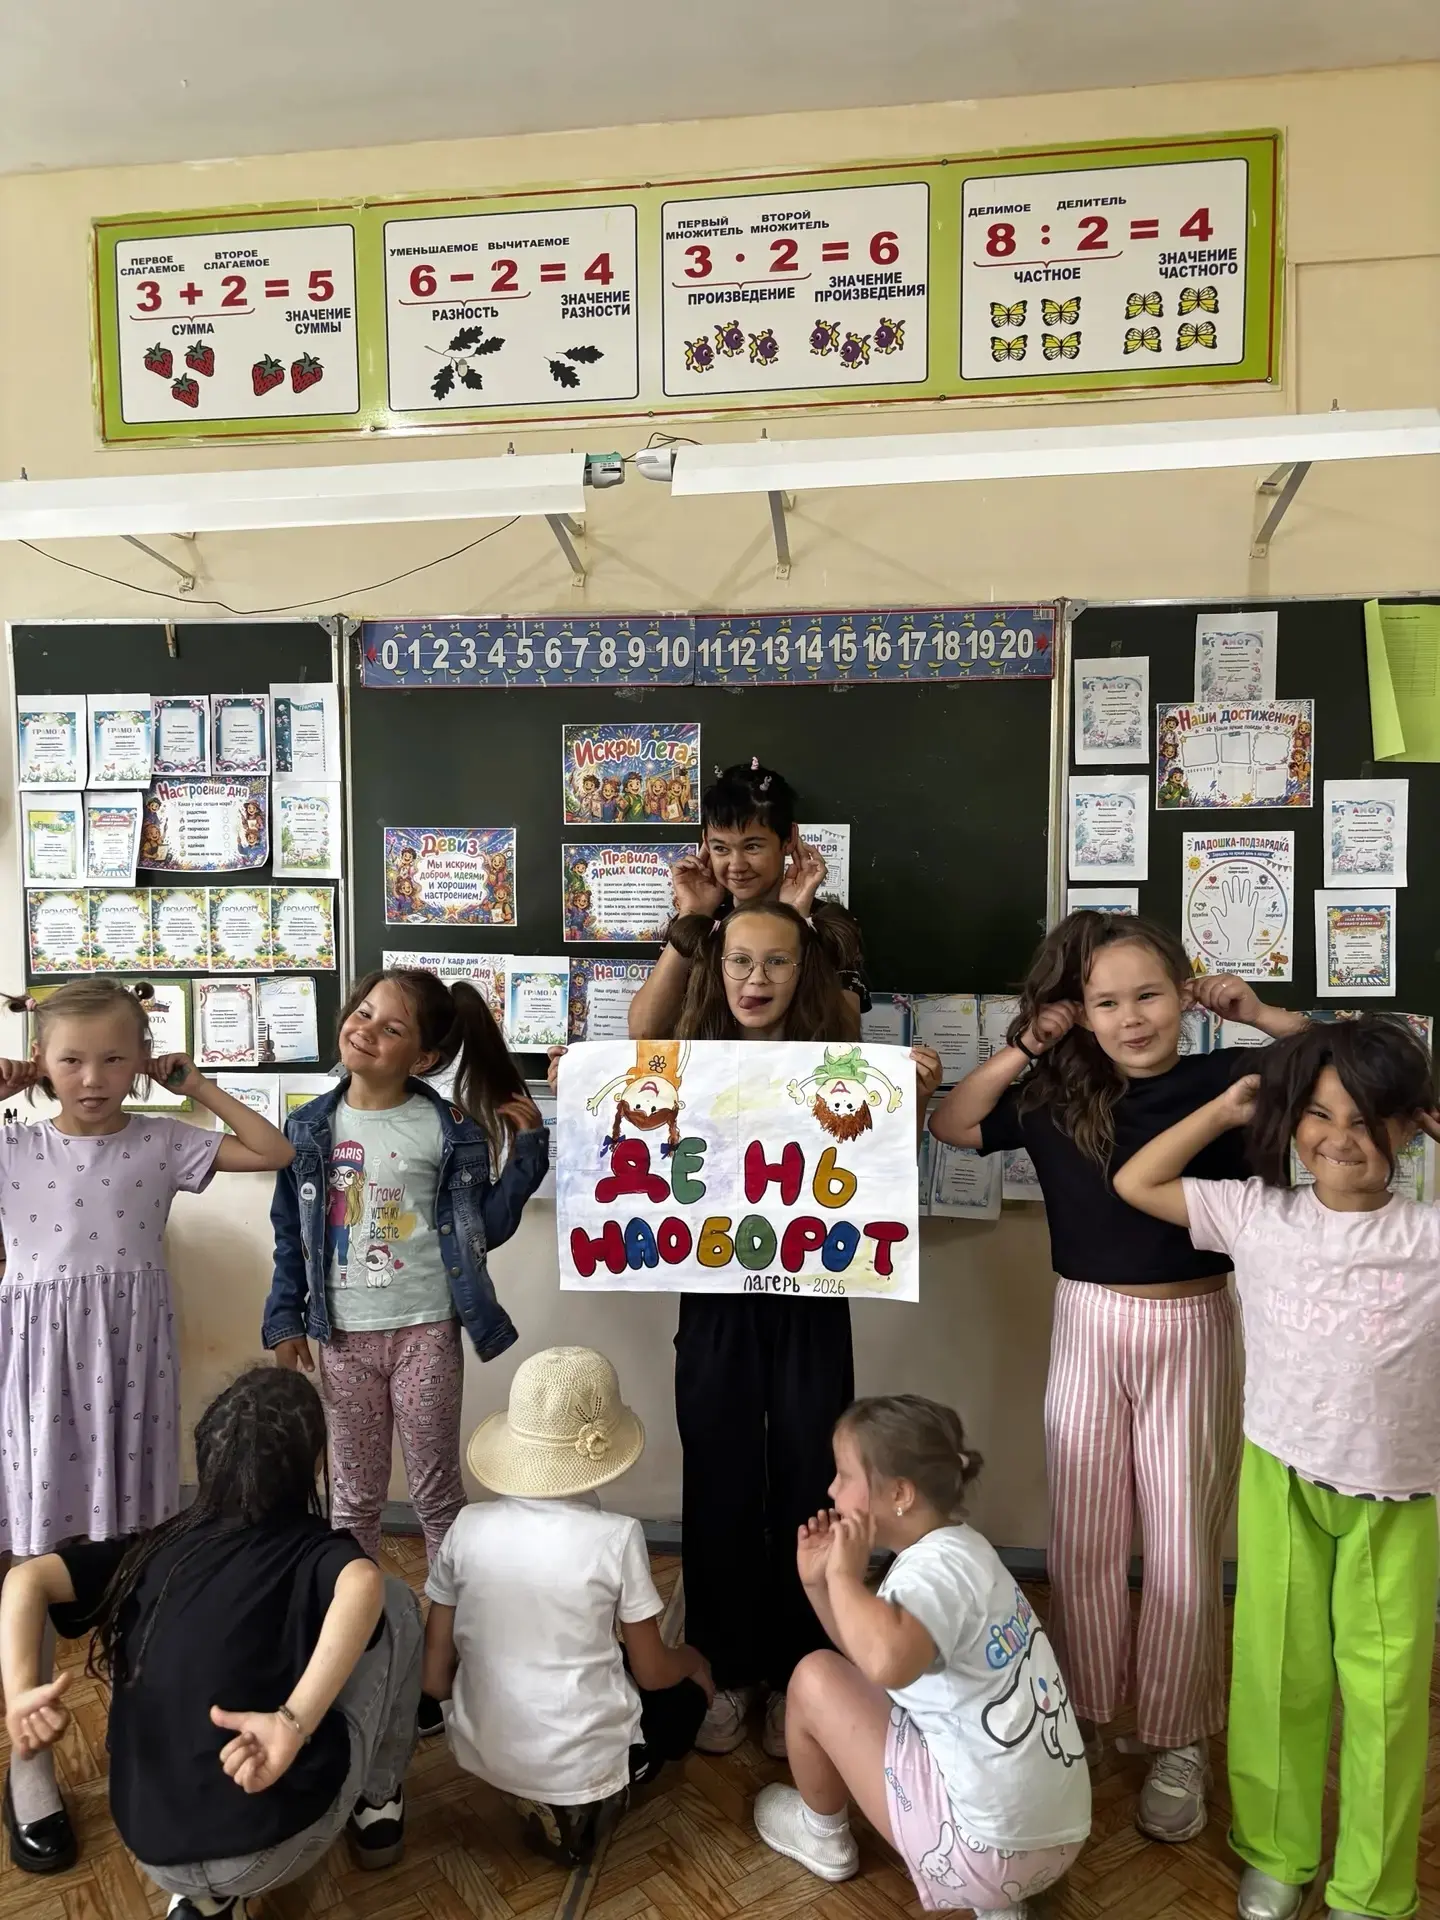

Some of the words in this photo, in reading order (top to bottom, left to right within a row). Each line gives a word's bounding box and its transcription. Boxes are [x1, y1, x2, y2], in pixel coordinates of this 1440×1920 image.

[968, 203, 1031, 217] ДЕЛИМОЕ
[1057, 196, 1127, 211] ДЕЛИТЕЛЬ
[678, 216, 729, 230] ПЕРВЫЙ
[761, 210, 811, 224] ВТОРОЙ
[665, 225, 743, 241] МНОЖИТЕЛЬ
[750, 218, 830, 234] МНОЖИТЕЛЬ
[985, 222, 1016, 257] 8
[1078, 216, 1108, 252] 2
[1179, 208, 1213, 243] 4
[215, 249, 258, 260] ВТОРОЕ
[389, 242, 478, 257] УМЕНЬШАЕМОЕ
[487, 237, 570, 251] ВЫЧИТАЕМОЕ
[684, 244, 712, 278] 3
[770, 240, 798, 273] 2
[870, 231, 900, 266] 6
[130, 255, 174, 266] ПЕРВОЕ
[204, 258, 270, 270] СЛАГАЕМОЕ
[1158, 248, 1237, 266] ЗНАЧЕНИЕ
[120, 264, 185, 275] СЛАГАЕМОЕ
[410, 264, 437, 298] 6
[490, 258, 518, 293] 2
[584, 252, 614, 286] 4
[1014, 267, 1081, 283] ЧАСТНОЕ
[1158, 262, 1238, 280] ЧАСТНОГО
[829, 272, 903, 288] ЗНАЧЕНИЕ
[136, 280, 162, 312] 3
[221, 275, 248, 308] 2
[307, 270, 334, 302] 5
[561, 290, 630, 308] ЗНАЧЕНИЕ
[688, 287, 796, 306] ПРОИЗВЕДЕНИЕ
[814, 283, 926, 303] ПРОИЗВЕДЕНИЯ
[284, 308, 352, 322] ЗНАЧЕНИЕ
[432, 306, 499, 322] РАЗНОСТЬ
[561, 304, 631, 320] РАЗНОСТИ
[172, 322, 215, 336] СУММА
[295, 320, 342, 336] СУММЫ
[811, 617, 822, 625] +1
[841, 616, 852, 624] +1
[902, 615, 913, 623] +1
[963, 613, 974, 621] +1
[994, 612, 1006, 620] +1
[382, 639, 398, 669] 0
[407, 639, 420, 669] 1
[433, 639, 449, 669] 2
[460, 638, 477, 669] 3
[487, 638, 506, 668] 4
[516, 639, 533, 668] 5
[544, 638, 562, 668] 6
[571, 638, 589, 668] 7
[599, 638, 617, 668] 8
[627, 637, 645, 667] 9
[655, 637, 690, 667] 10
[698, 638, 722, 667] 11
[728, 638, 756, 666] 12
[761, 636, 789, 665] 13
[795, 634, 823, 664] 14
[828, 633, 857, 662] 15
[863, 632, 891, 662] 16
[898, 632, 926, 661] 17
[931, 631, 961, 661] 18
[966, 629, 995, 660] 19
[1001, 628, 1033, 658] 20
[1179, 710, 1216, 731] Наши
[1220, 708, 1297, 726] достижения
[575, 740, 640, 768] Искры
[641, 740, 689, 763] лета
[158, 782, 226, 800] Настроение
[227, 786, 248, 798] дня
[422, 836, 478, 857] Девиз
[1194, 836, 1290, 852] ЛАДОШКА-ПОДЗАРЯДКА
[601, 850, 658, 865] Правила
[427, 860, 442, 869] Мы
[446, 860, 477, 872] искрим
[629, 866, 669, 878] искорок
[454, 873, 484, 881] идеями
[438, 882, 477, 892] хорошим
[424, 890, 483, 901] настроением!
[420, 956, 440, 964] Фото
[448, 958, 464, 966] кадр
[440, 967, 471, 976] нашего
[472, 968, 490, 979] дня
[594, 964, 625, 980] Наш
[333, 1148, 362, 1160] PARIS
[369, 1183, 406, 1202] Travel
[371, 1207, 388, 1220] WITH
[370, 1222, 400, 1239] Bestie
[570, 1214, 910, 1278] НАОБОРОТ
[812, 1278, 846, 1296] 2026
